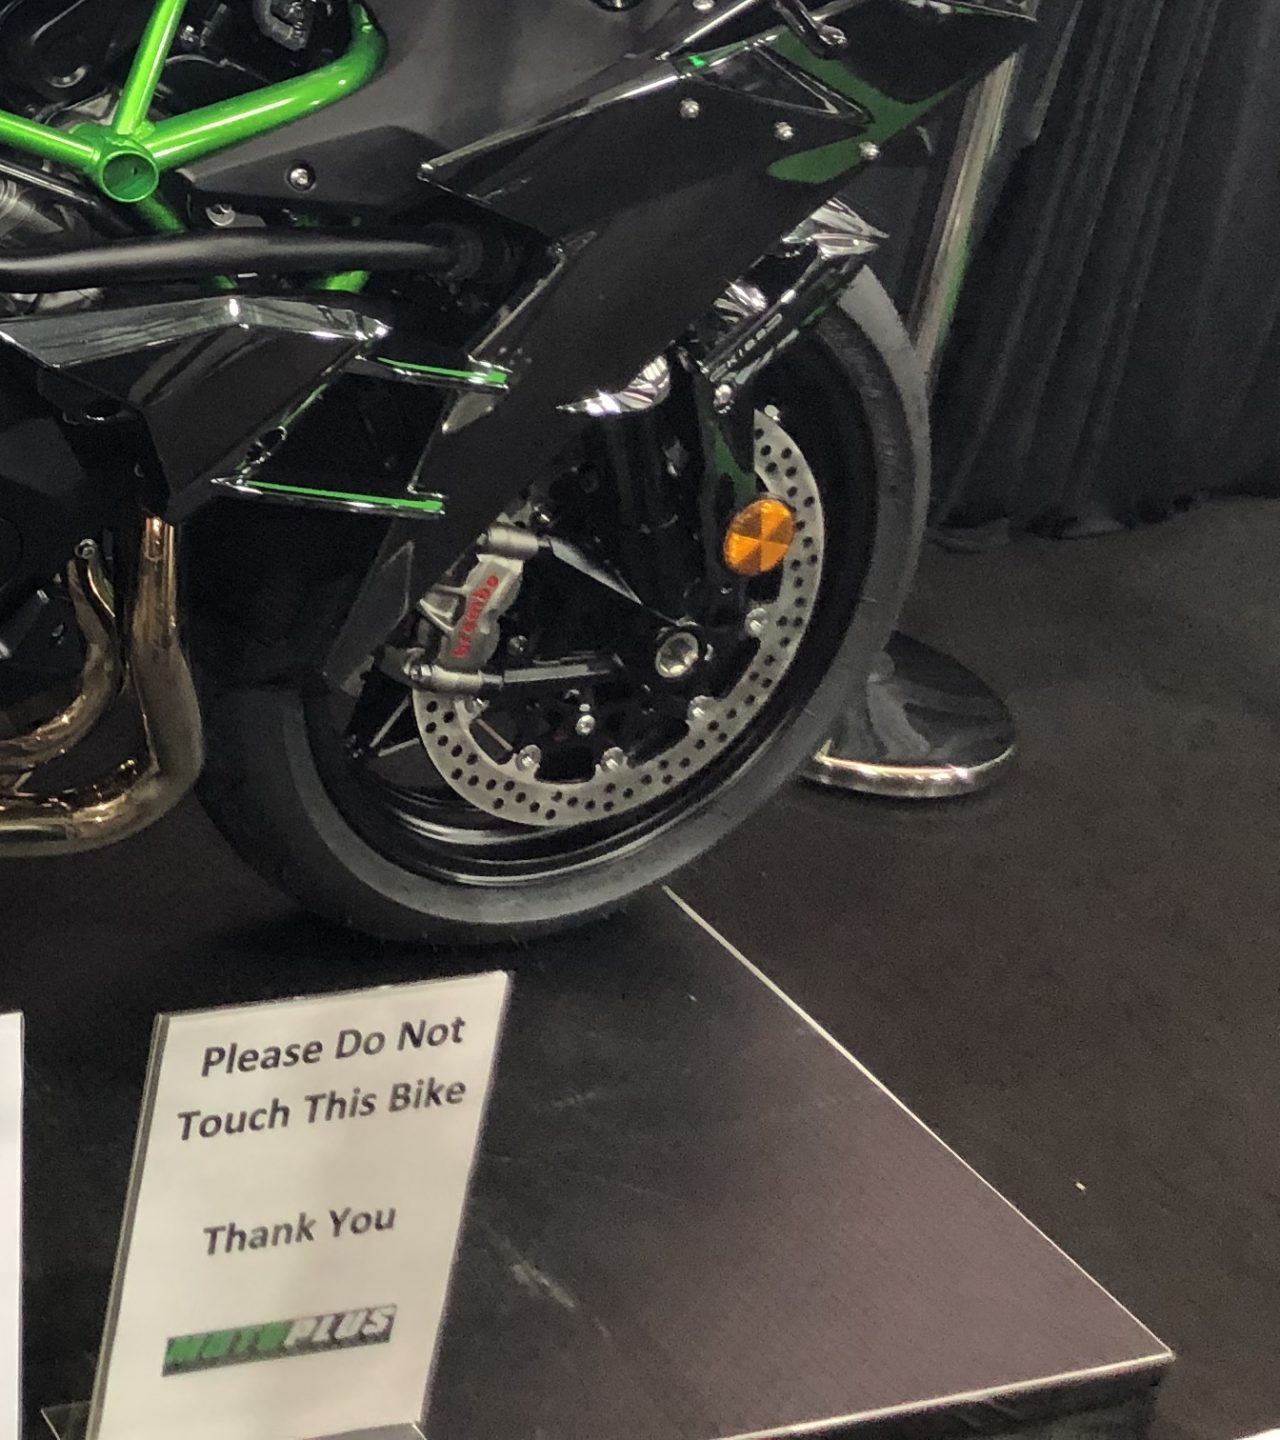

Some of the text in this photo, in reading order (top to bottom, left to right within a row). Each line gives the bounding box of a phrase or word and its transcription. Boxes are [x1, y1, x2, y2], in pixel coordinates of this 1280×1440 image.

[200, 1016, 467, 1077] Please Do Not
[177, 1076, 467, 1142] Touch This Bike
[202, 1206, 397, 1257] Thank You
